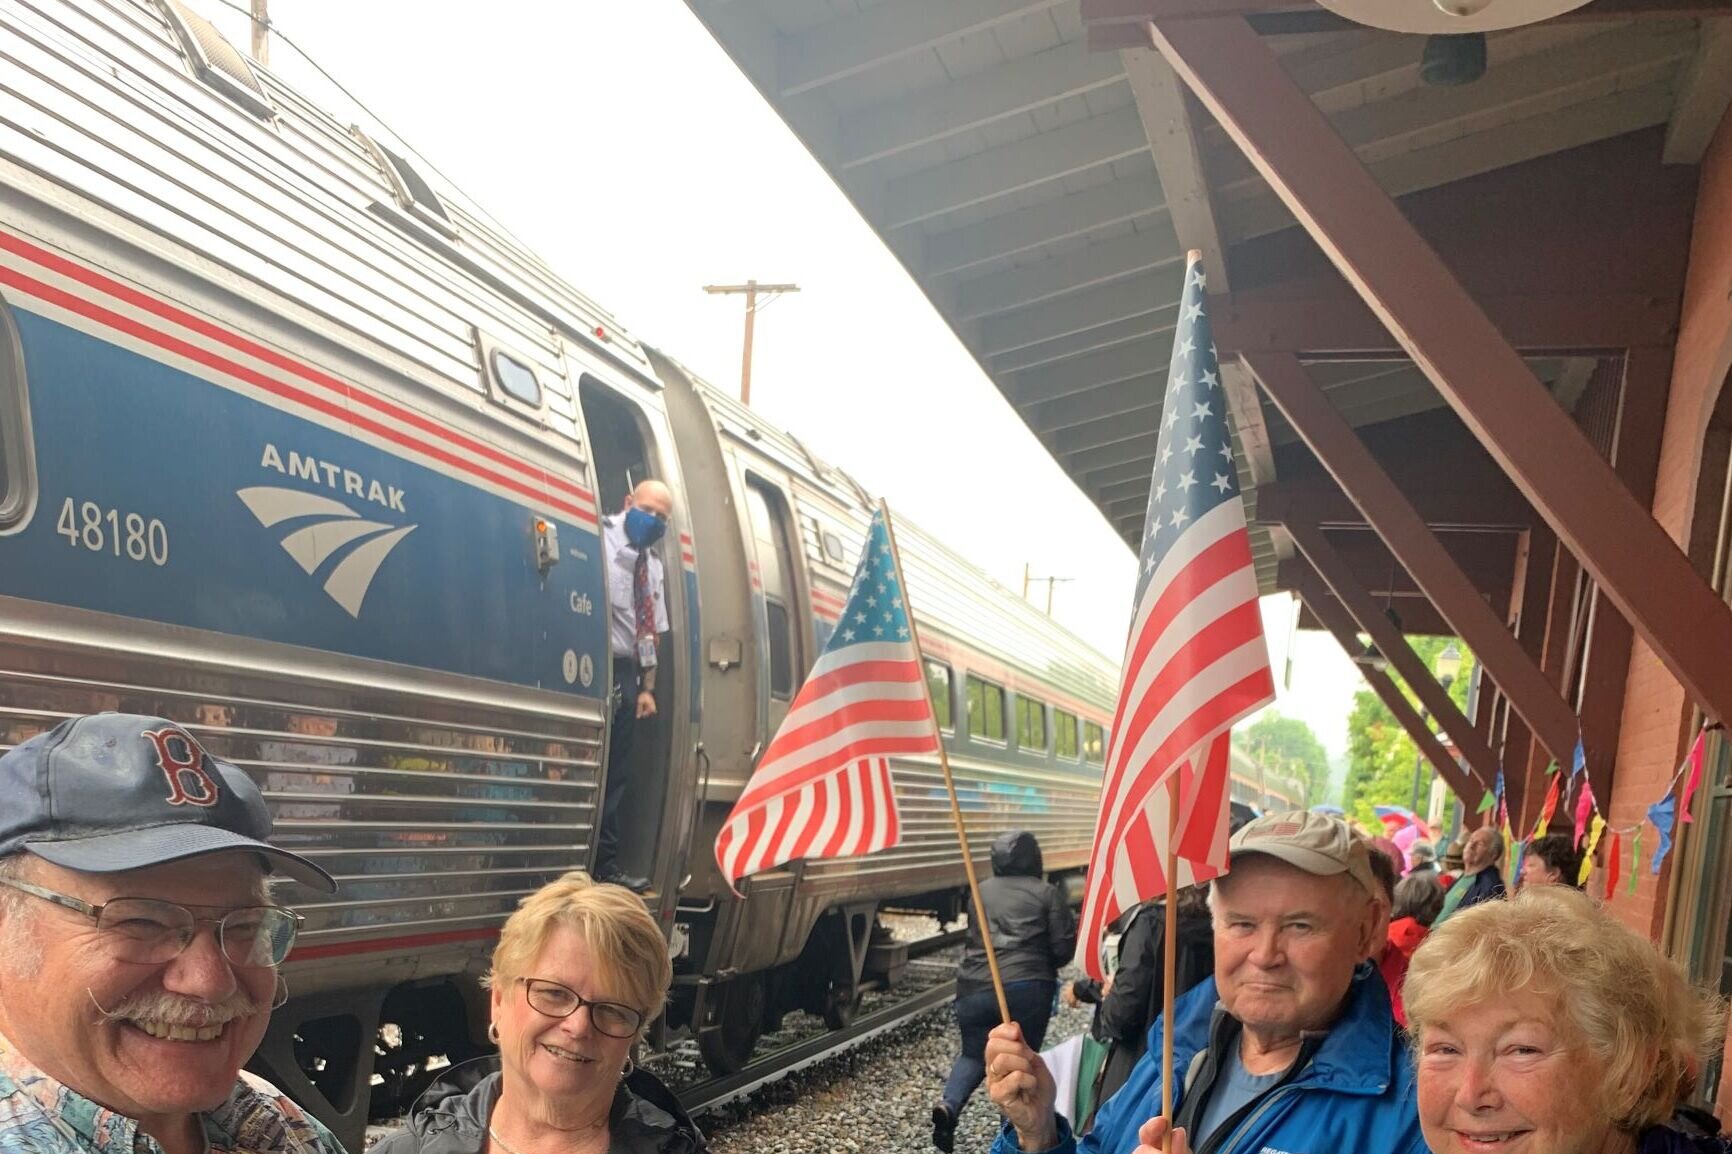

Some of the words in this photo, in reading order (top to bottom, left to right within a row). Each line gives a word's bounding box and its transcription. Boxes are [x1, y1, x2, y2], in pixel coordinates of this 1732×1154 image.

[261, 443, 406, 513] AMTRAK
[57, 497, 168, 566] 48180
[570, 590, 592, 616] Cafe
[140, 727, 218, 807] B
